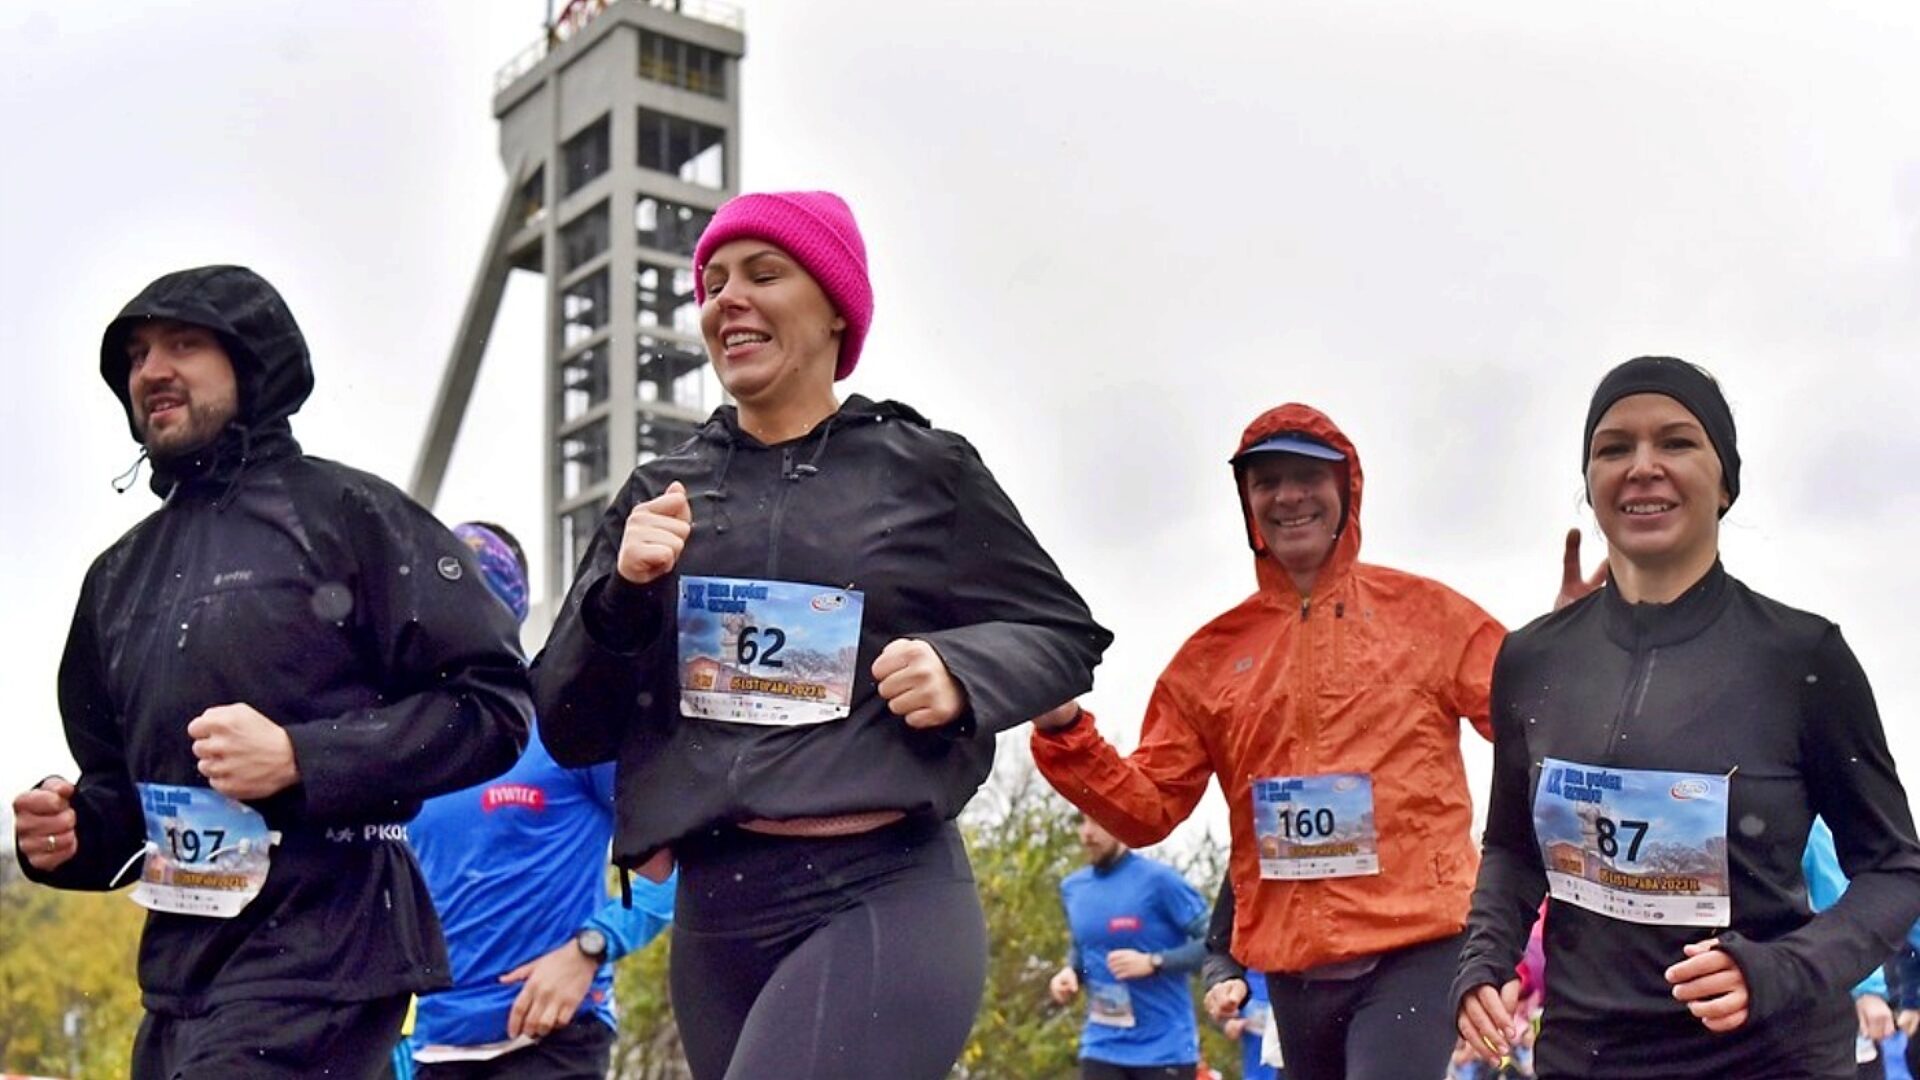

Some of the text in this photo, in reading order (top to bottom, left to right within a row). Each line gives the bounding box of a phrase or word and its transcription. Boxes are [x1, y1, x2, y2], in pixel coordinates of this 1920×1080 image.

[737, 626, 787, 667] 62
[1280, 808, 1335, 837] 160
[1596, 816, 1649, 862] 87
[167, 827, 225, 864] 197
[1609, 870, 1660, 891] LISTOPADA
[1661, 877, 1689, 891] 2023
